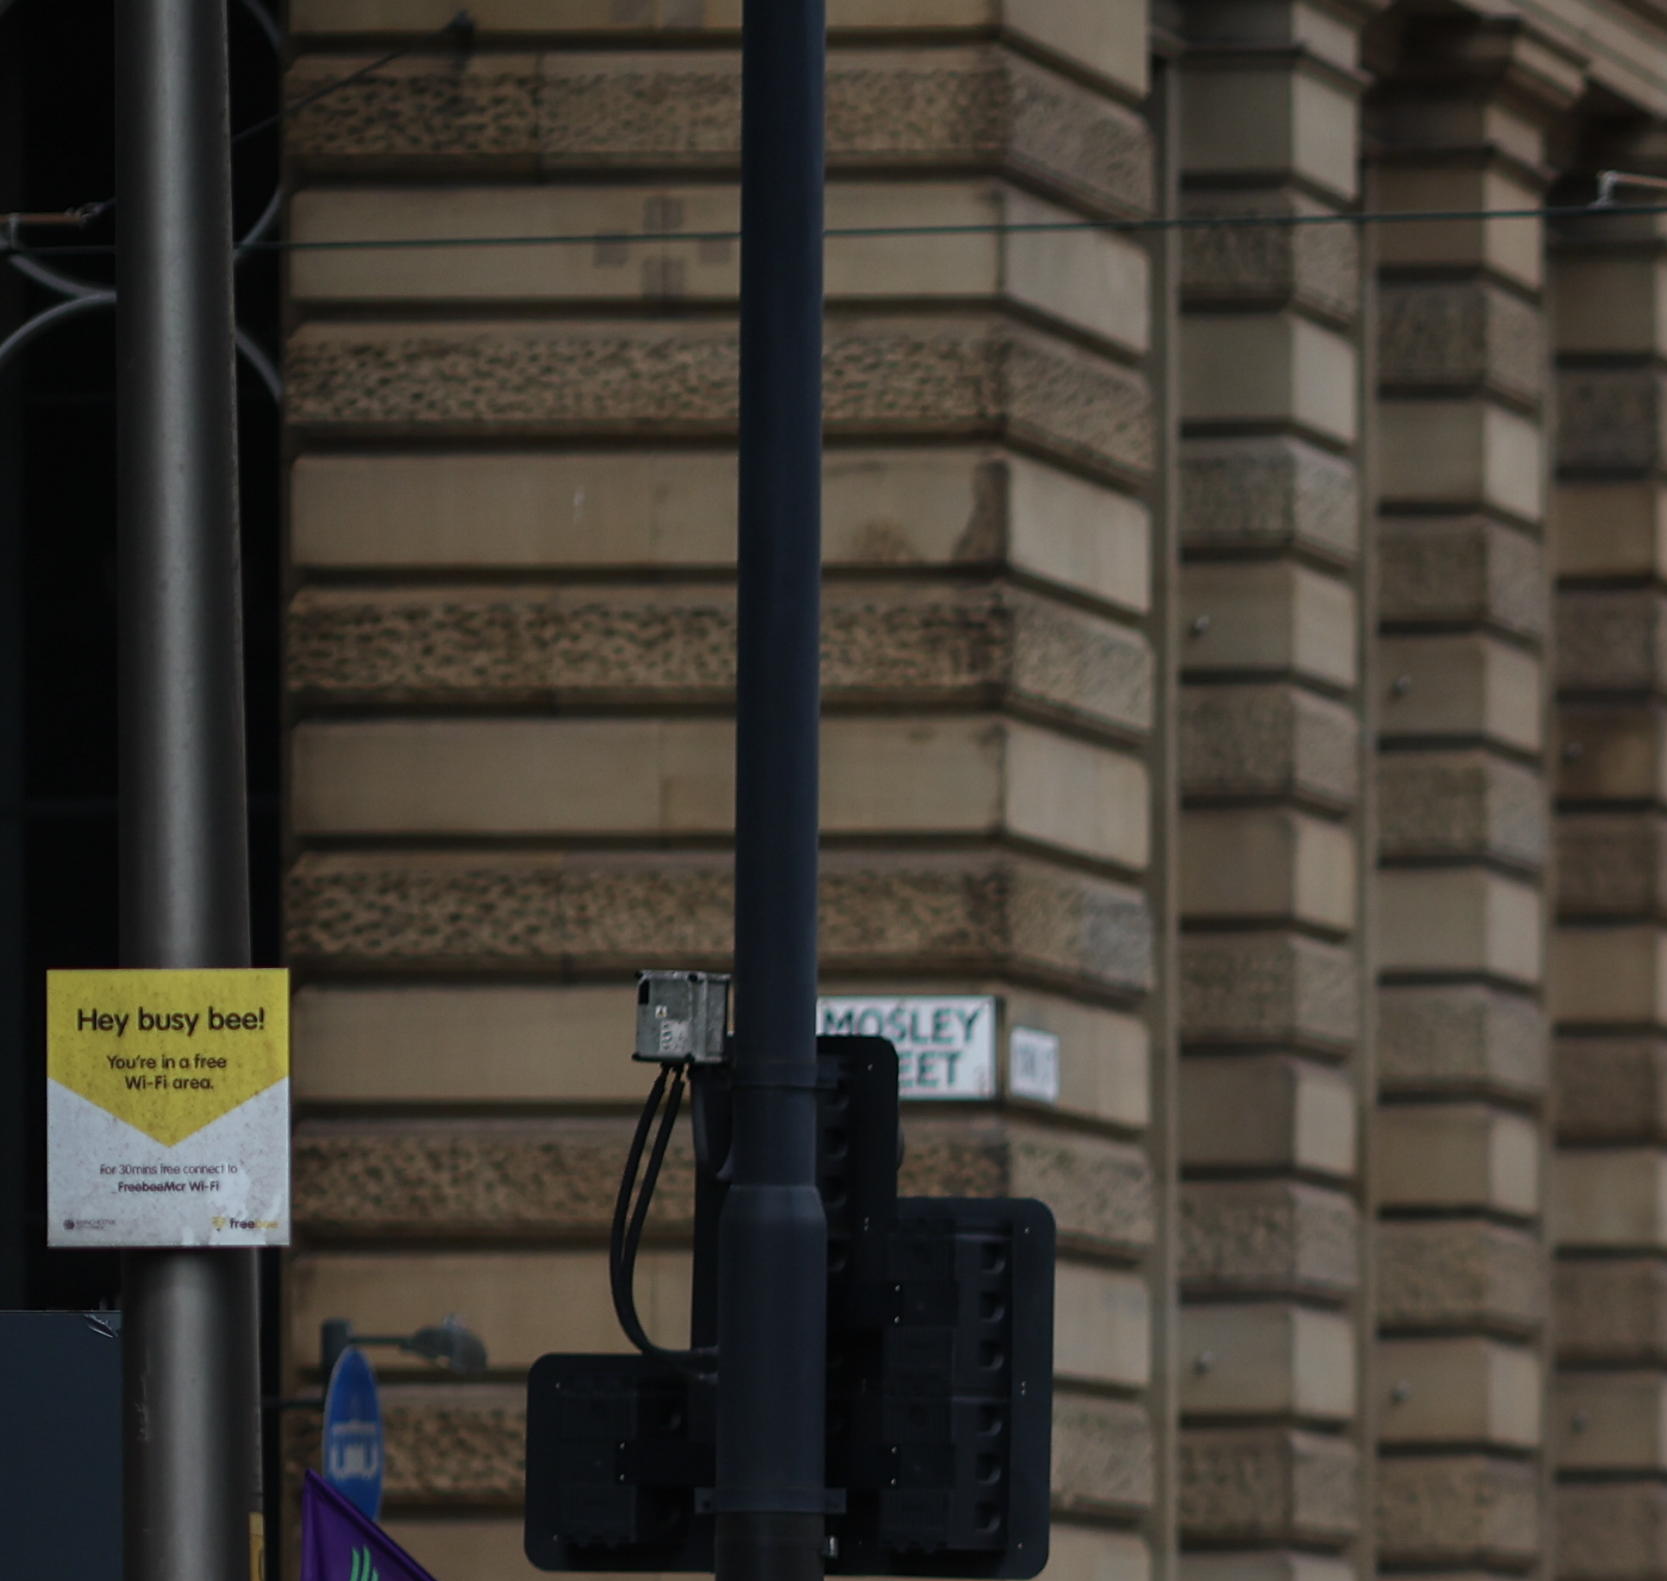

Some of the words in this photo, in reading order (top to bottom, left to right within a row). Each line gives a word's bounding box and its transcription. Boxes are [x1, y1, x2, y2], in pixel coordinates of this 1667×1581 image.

[77, 1007, 129, 1037] Hey
[138, 1006, 199, 1037] busy
[208, 1006, 265, 1031] bee!
[822, 1008, 984, 1044] MOSLEY
[107, 1055, 156, 1070] You're
[162, 1054, 176, 1069] in
[179, 1057, 190, 1069] a
[193, 1053, 227, 1069] free
[899, 1052, 963, 1087] EET
[125, 1075, 168, 1090] Wi-Fi
[172, 1077, 214, 1090] area.
[100, 1164, 116, 1175] For
[118, 1164, 157, 1175] 30mins
[160, 1163, 180, 1175] free
[183, 1164, 225, 1175] connect
[228, 1164, 238, 1175] to
[118, 1181, 185, 1193] FreebeeMcr
[189, 1181, 220, 1193] Wi-Fi
